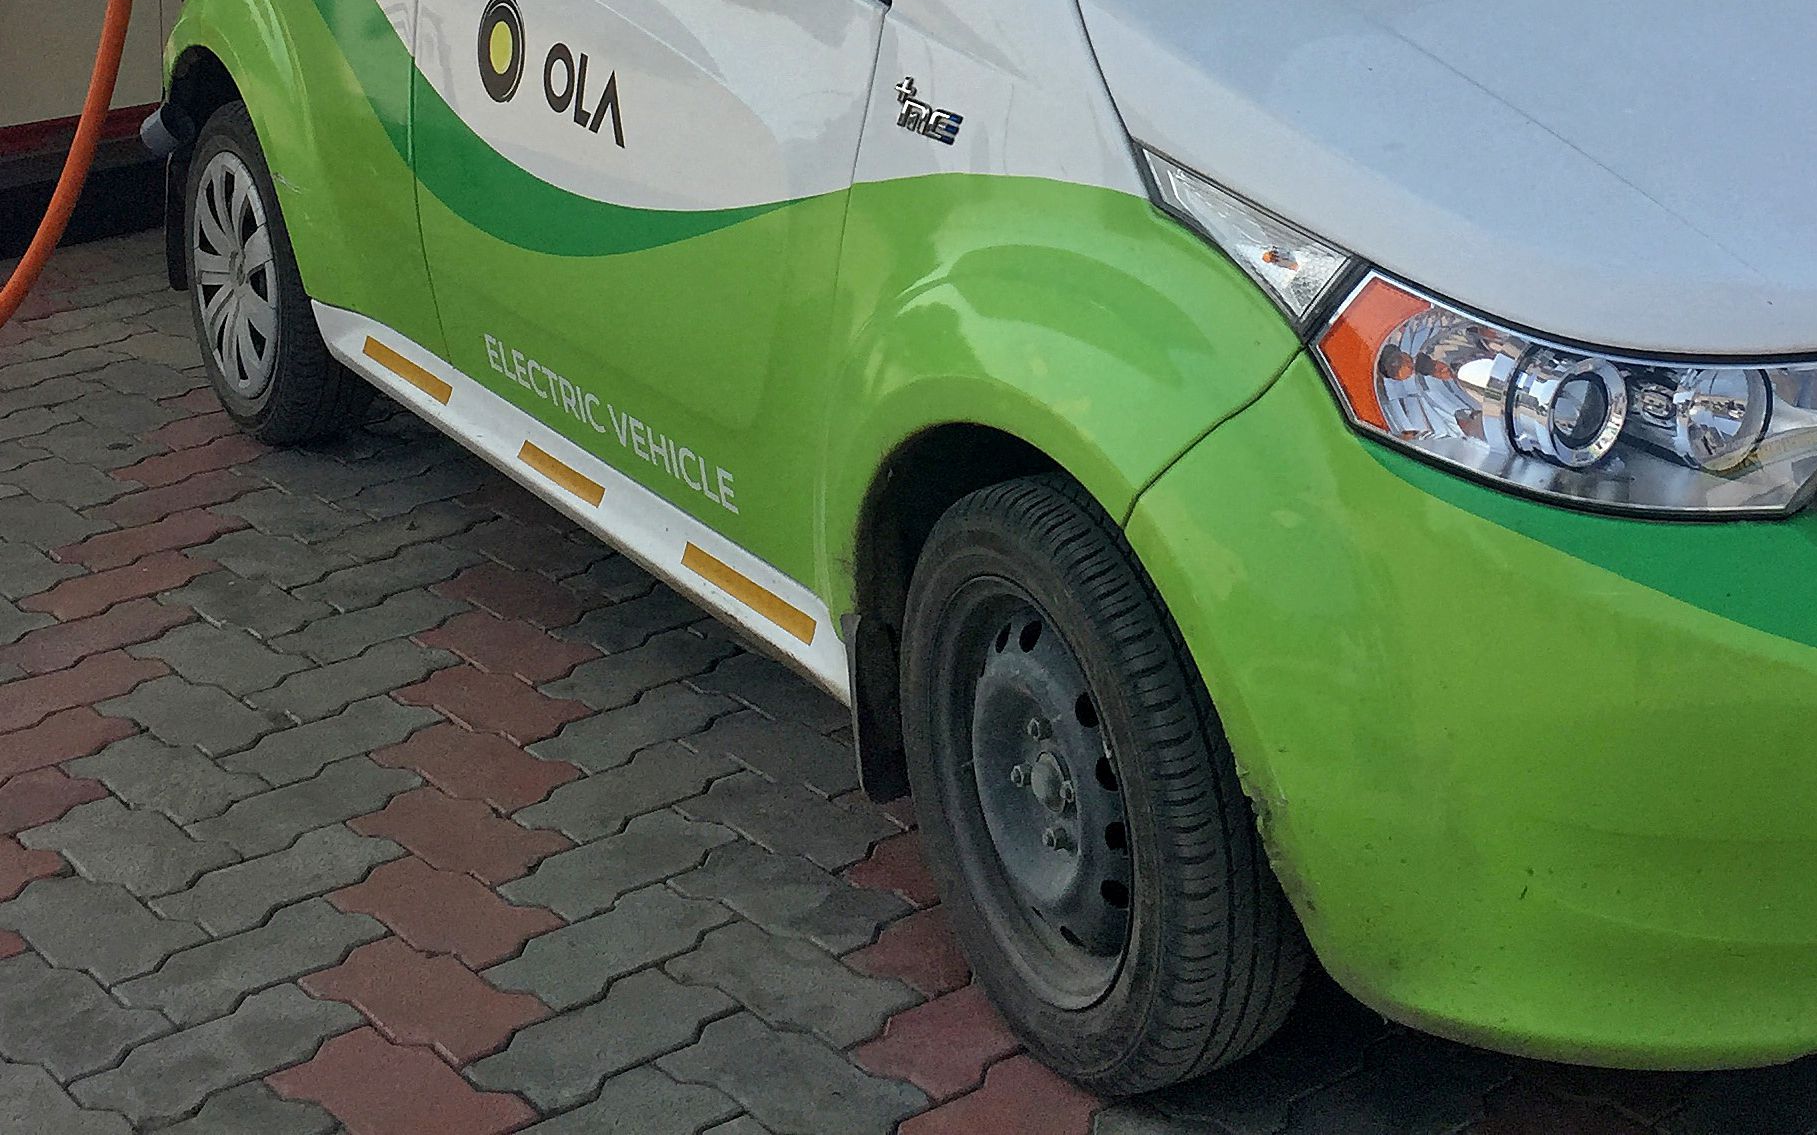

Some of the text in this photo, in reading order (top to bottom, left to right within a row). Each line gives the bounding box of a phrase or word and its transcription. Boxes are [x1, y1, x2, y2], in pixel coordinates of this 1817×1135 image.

[543, 43, 626, 149] OLA
[484, 333, 740, 515] ELECTRIC VEHICLE
